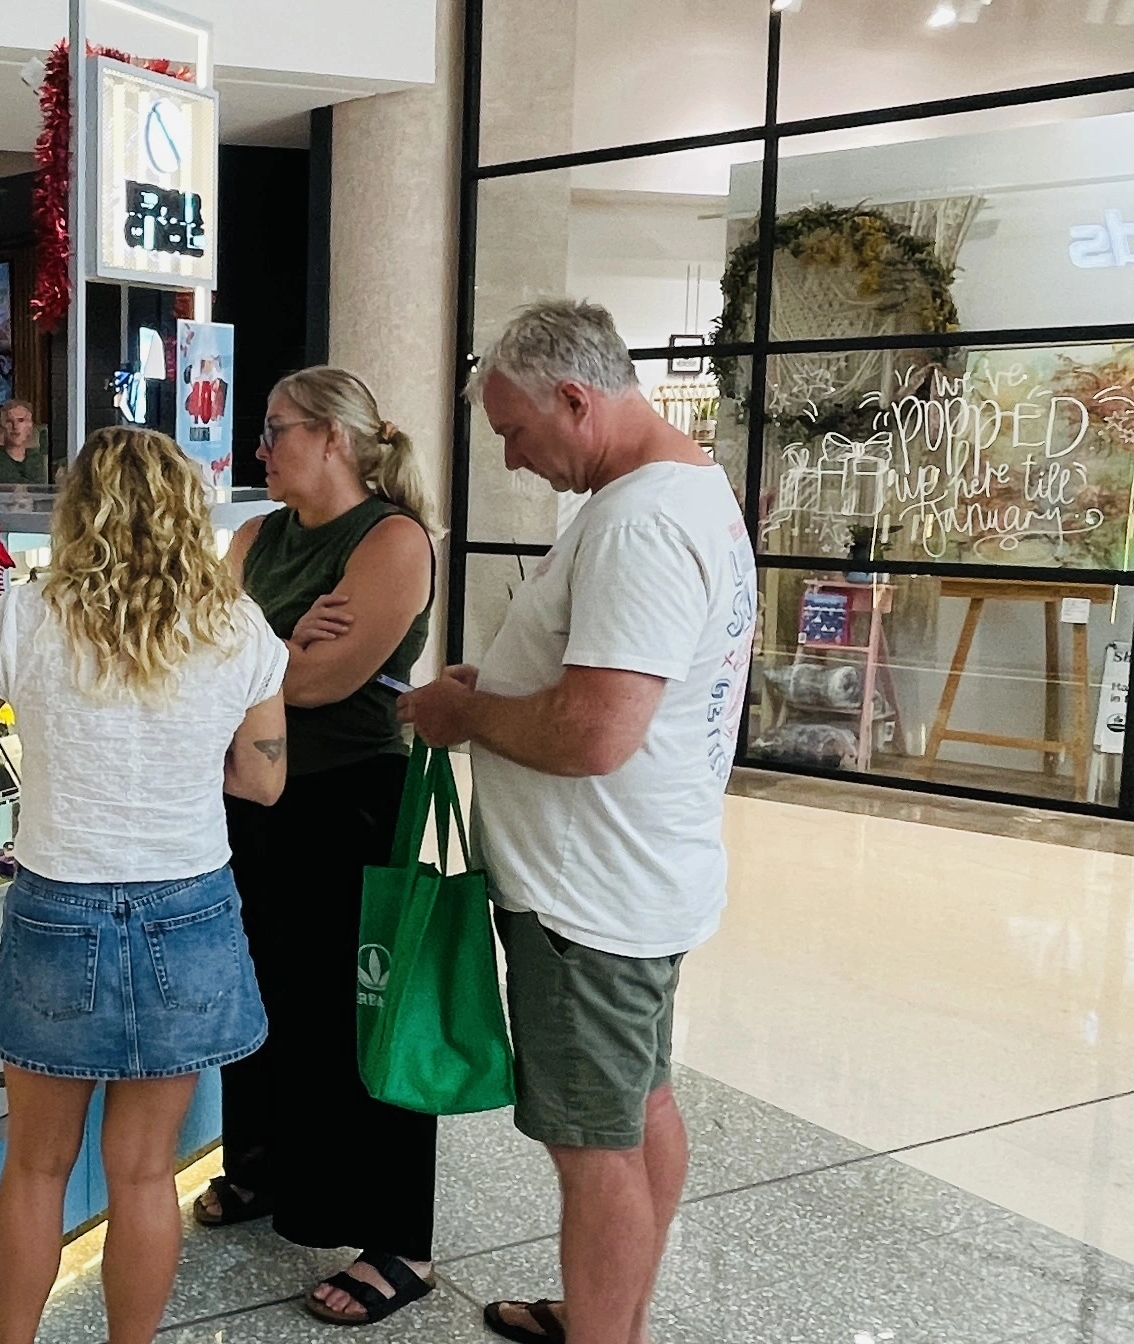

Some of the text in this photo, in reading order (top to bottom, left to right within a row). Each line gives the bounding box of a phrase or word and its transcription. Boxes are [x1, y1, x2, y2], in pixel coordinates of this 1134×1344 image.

[896, 440, 1075, 522] up here till
